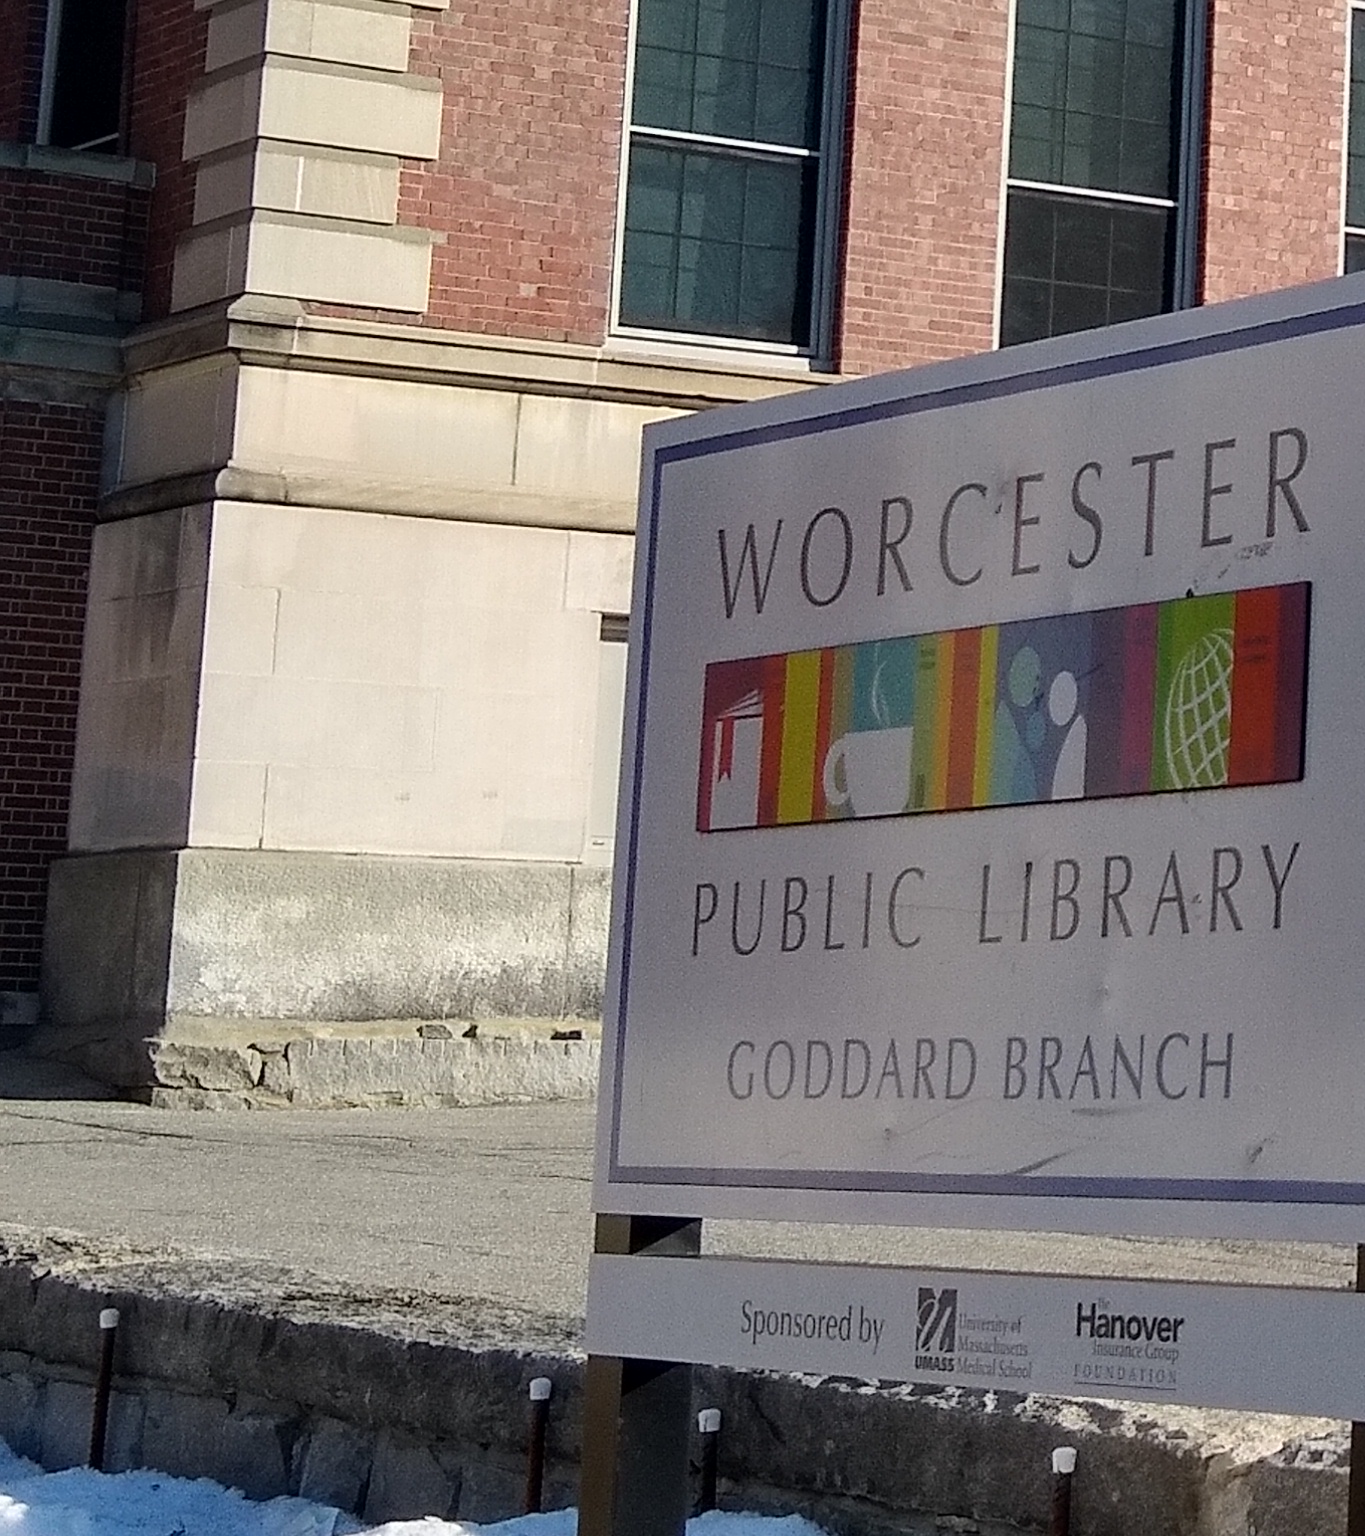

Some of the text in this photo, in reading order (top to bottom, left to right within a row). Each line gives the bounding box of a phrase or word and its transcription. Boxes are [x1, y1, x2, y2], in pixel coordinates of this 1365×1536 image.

[718, 427, 1311, 619] WORCESTER
[692, 842, 1301, 957] PUBLIC LIBRARY
[726, 1032, 1235, 1101] GODDARD BRANCH
[740, 1299, 886, 1356] Sponsored by
[1010, 1314, 1026, 1334] of
[1075, 1302, 1185, 1343] Hanover
[914, 1355, 955, 1372] UMASS
[1091, 1339, 1180, 1365] Insurance Group
[1073, 1363, 1177, 1384] FOUNDATION
